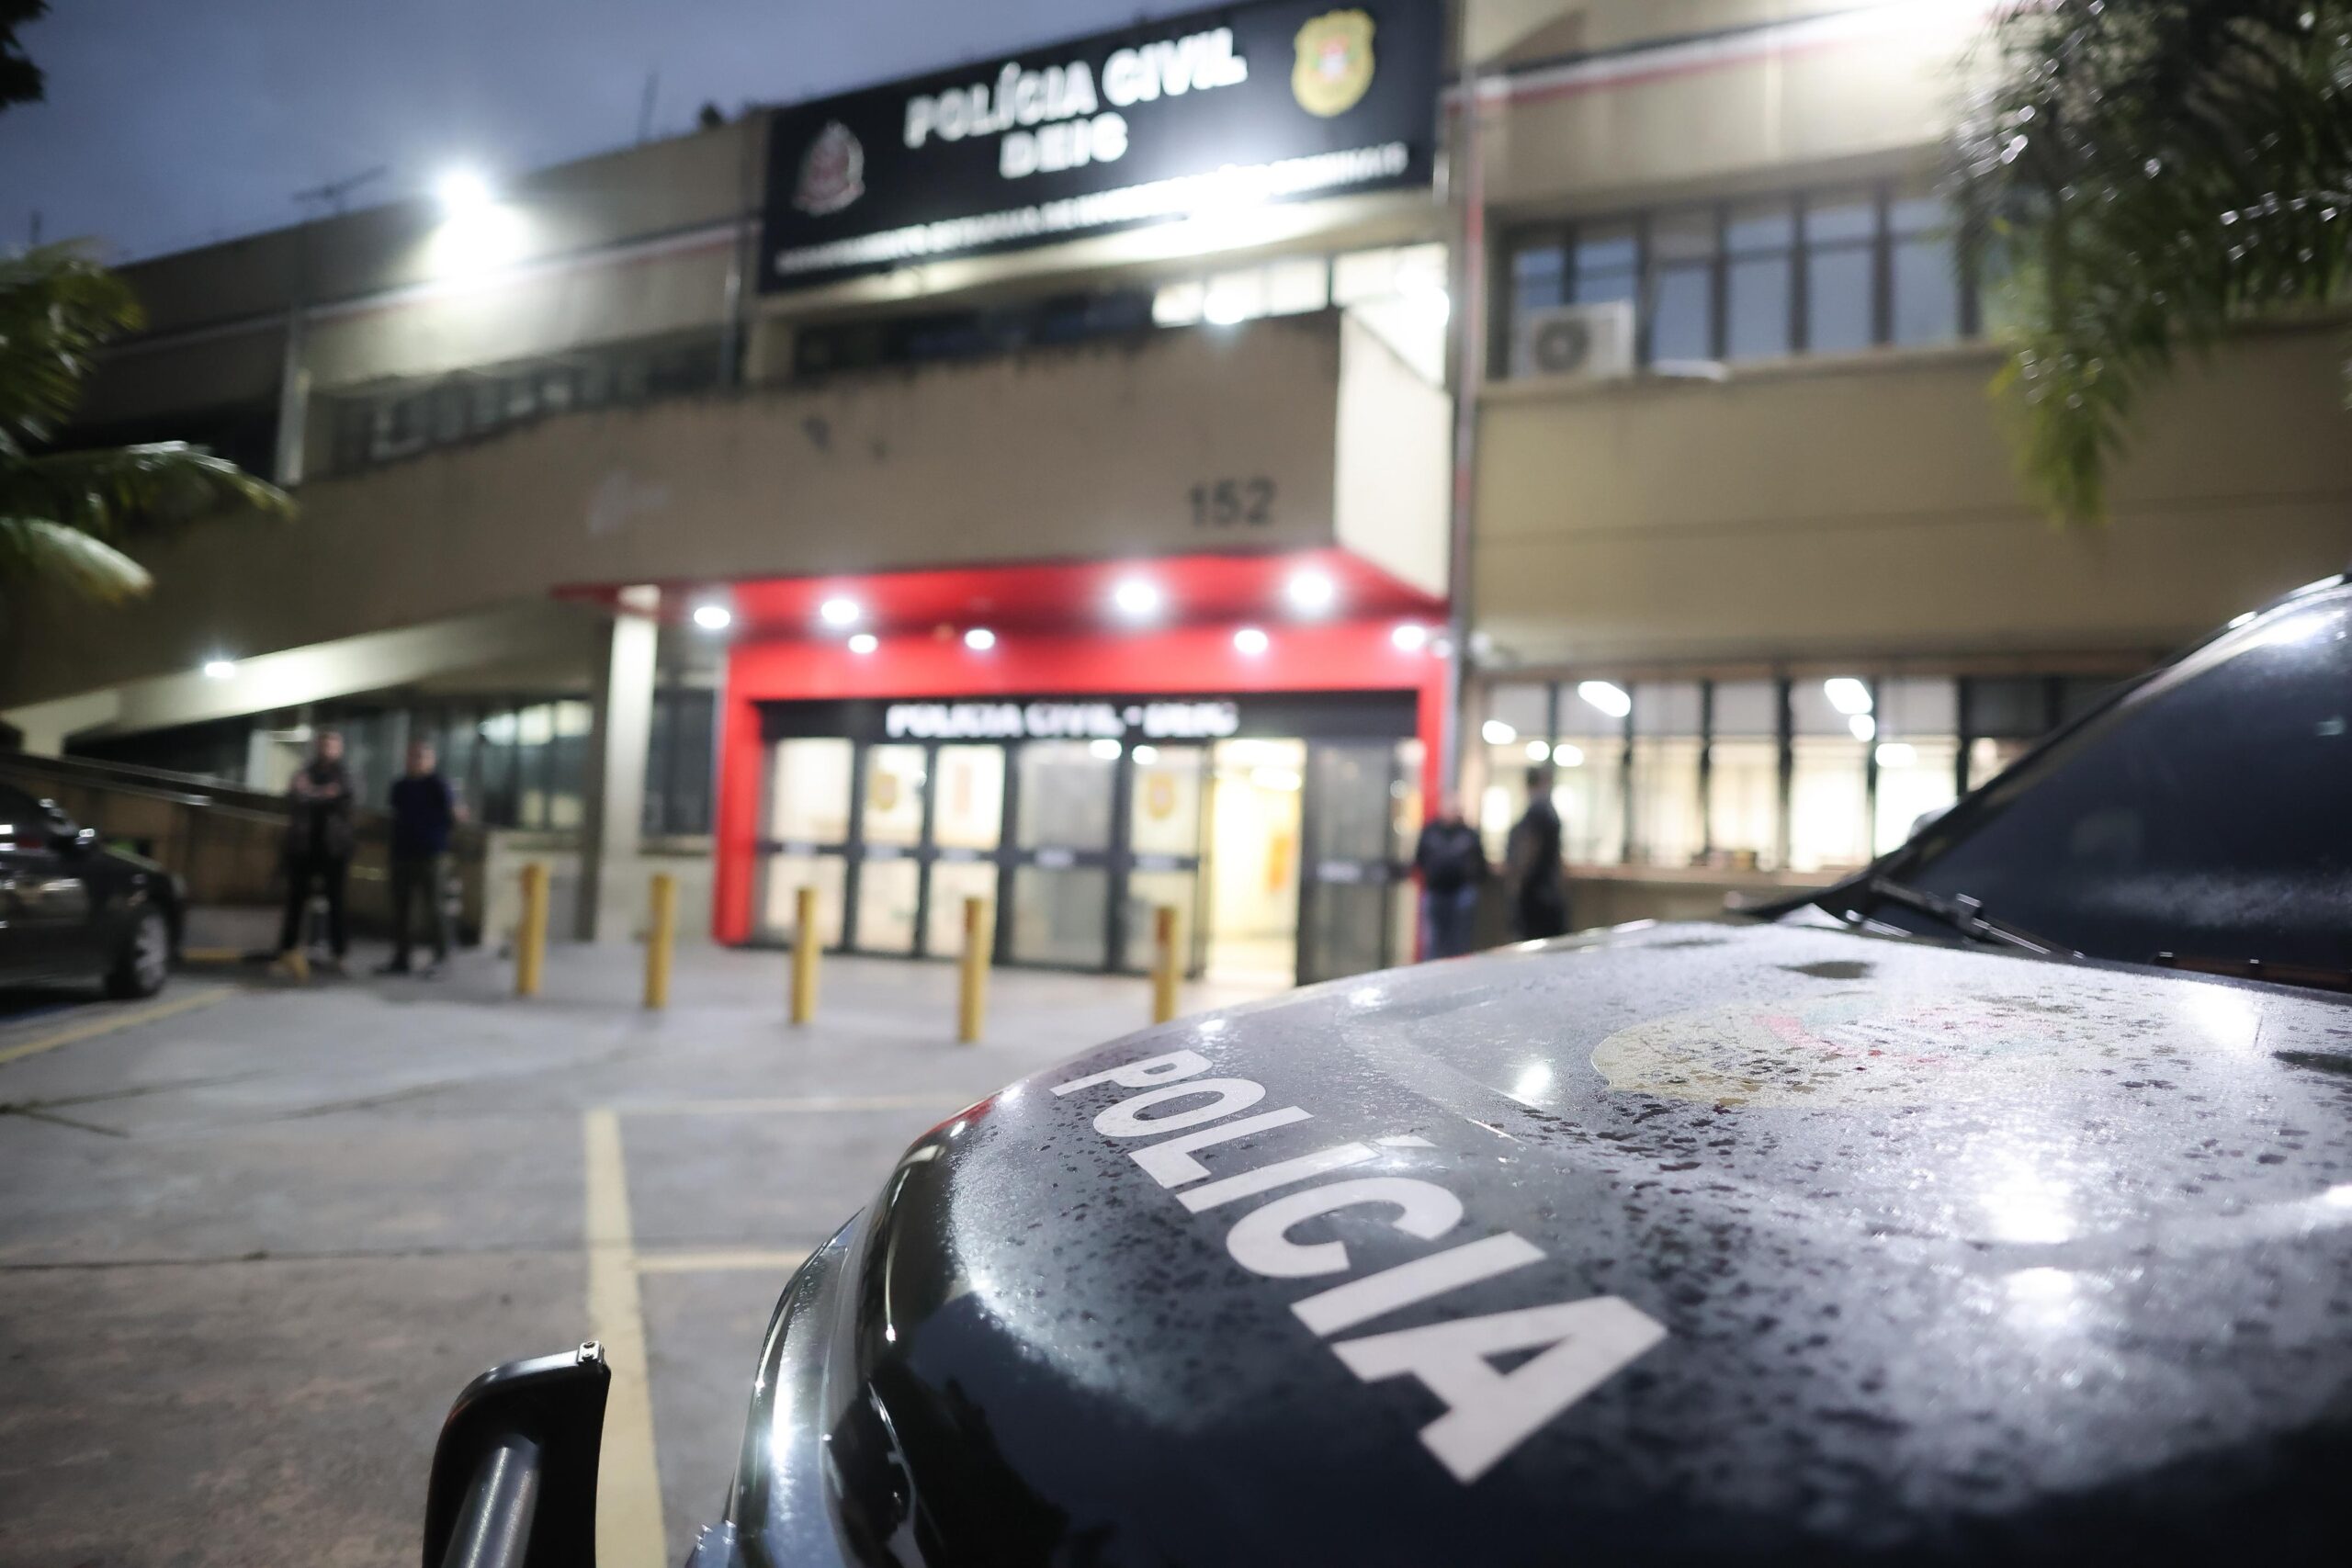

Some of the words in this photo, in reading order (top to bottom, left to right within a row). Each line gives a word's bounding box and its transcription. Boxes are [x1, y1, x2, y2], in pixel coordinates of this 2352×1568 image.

[904, 61, 1099, 149] POLÍCIA
[1102, 27, 1249, 107] CIVIL
[1190, 477, 1277, 528] 152
[1053, 1049, 1668, 1484] POLÍCIA
